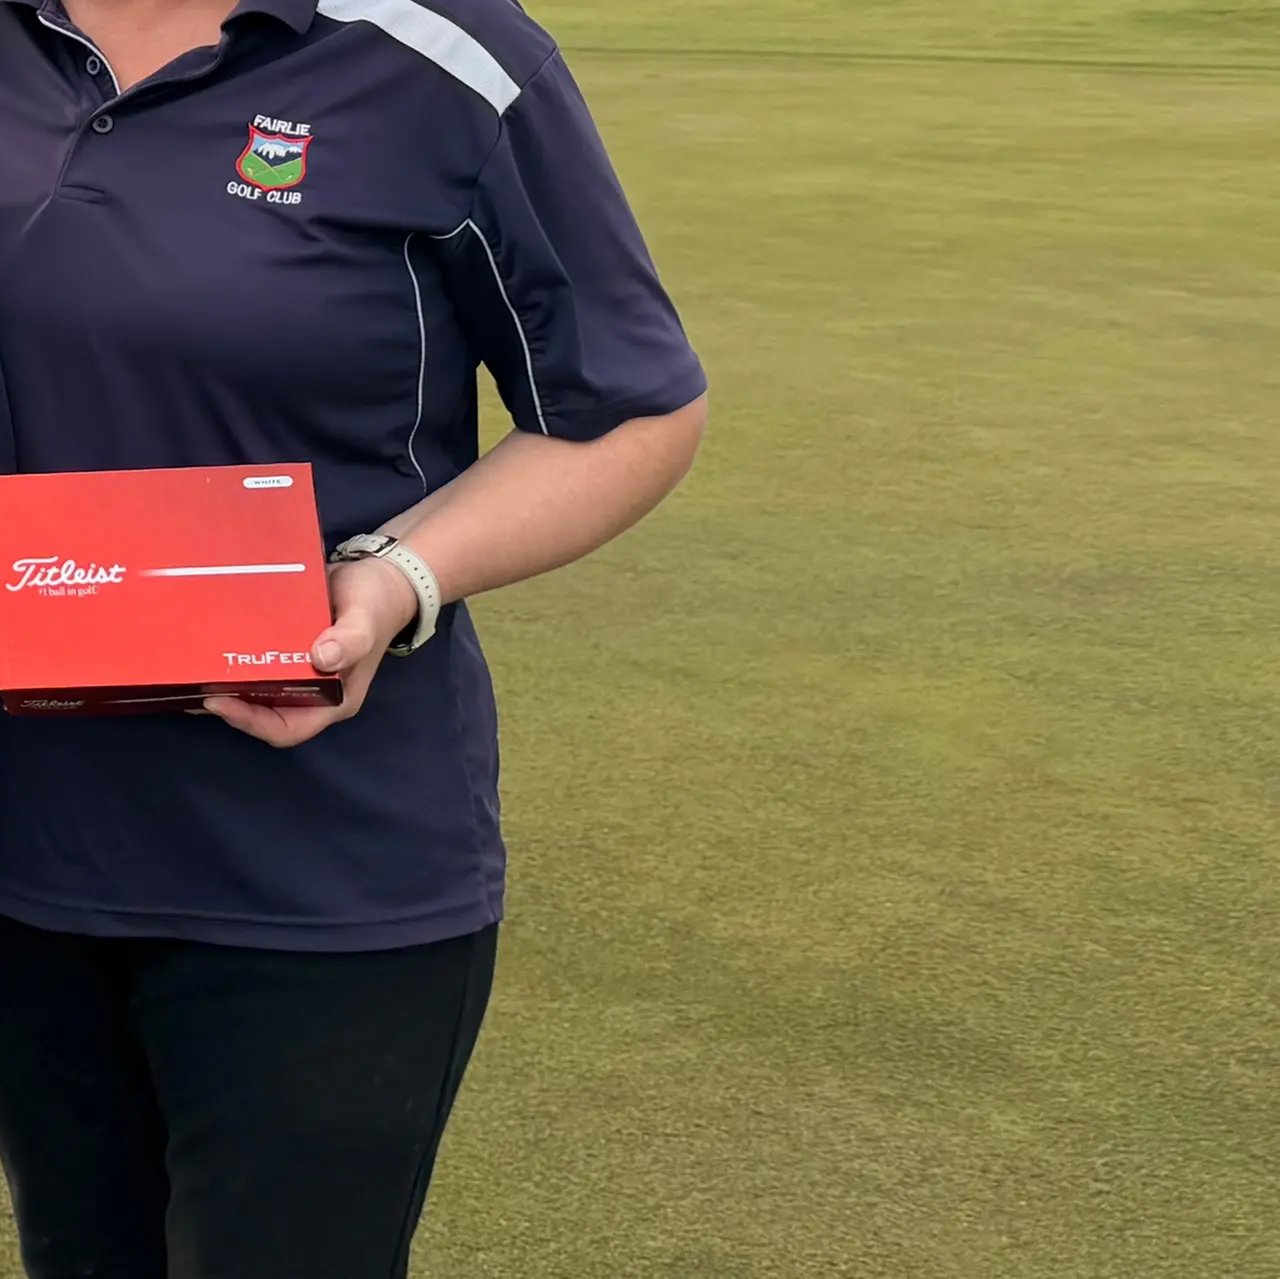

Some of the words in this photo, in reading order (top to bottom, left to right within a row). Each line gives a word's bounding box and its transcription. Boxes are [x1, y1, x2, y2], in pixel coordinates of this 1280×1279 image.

[253, 114, 311, 136] FAIRLIE
[226, 181, 262, 200] GOLF
[266, 190, 302, 204] CLUB
[5, 555, 127, 592] Titleist
[48, 586, 66, 596] ball
[67, 587, 77, 596] in
